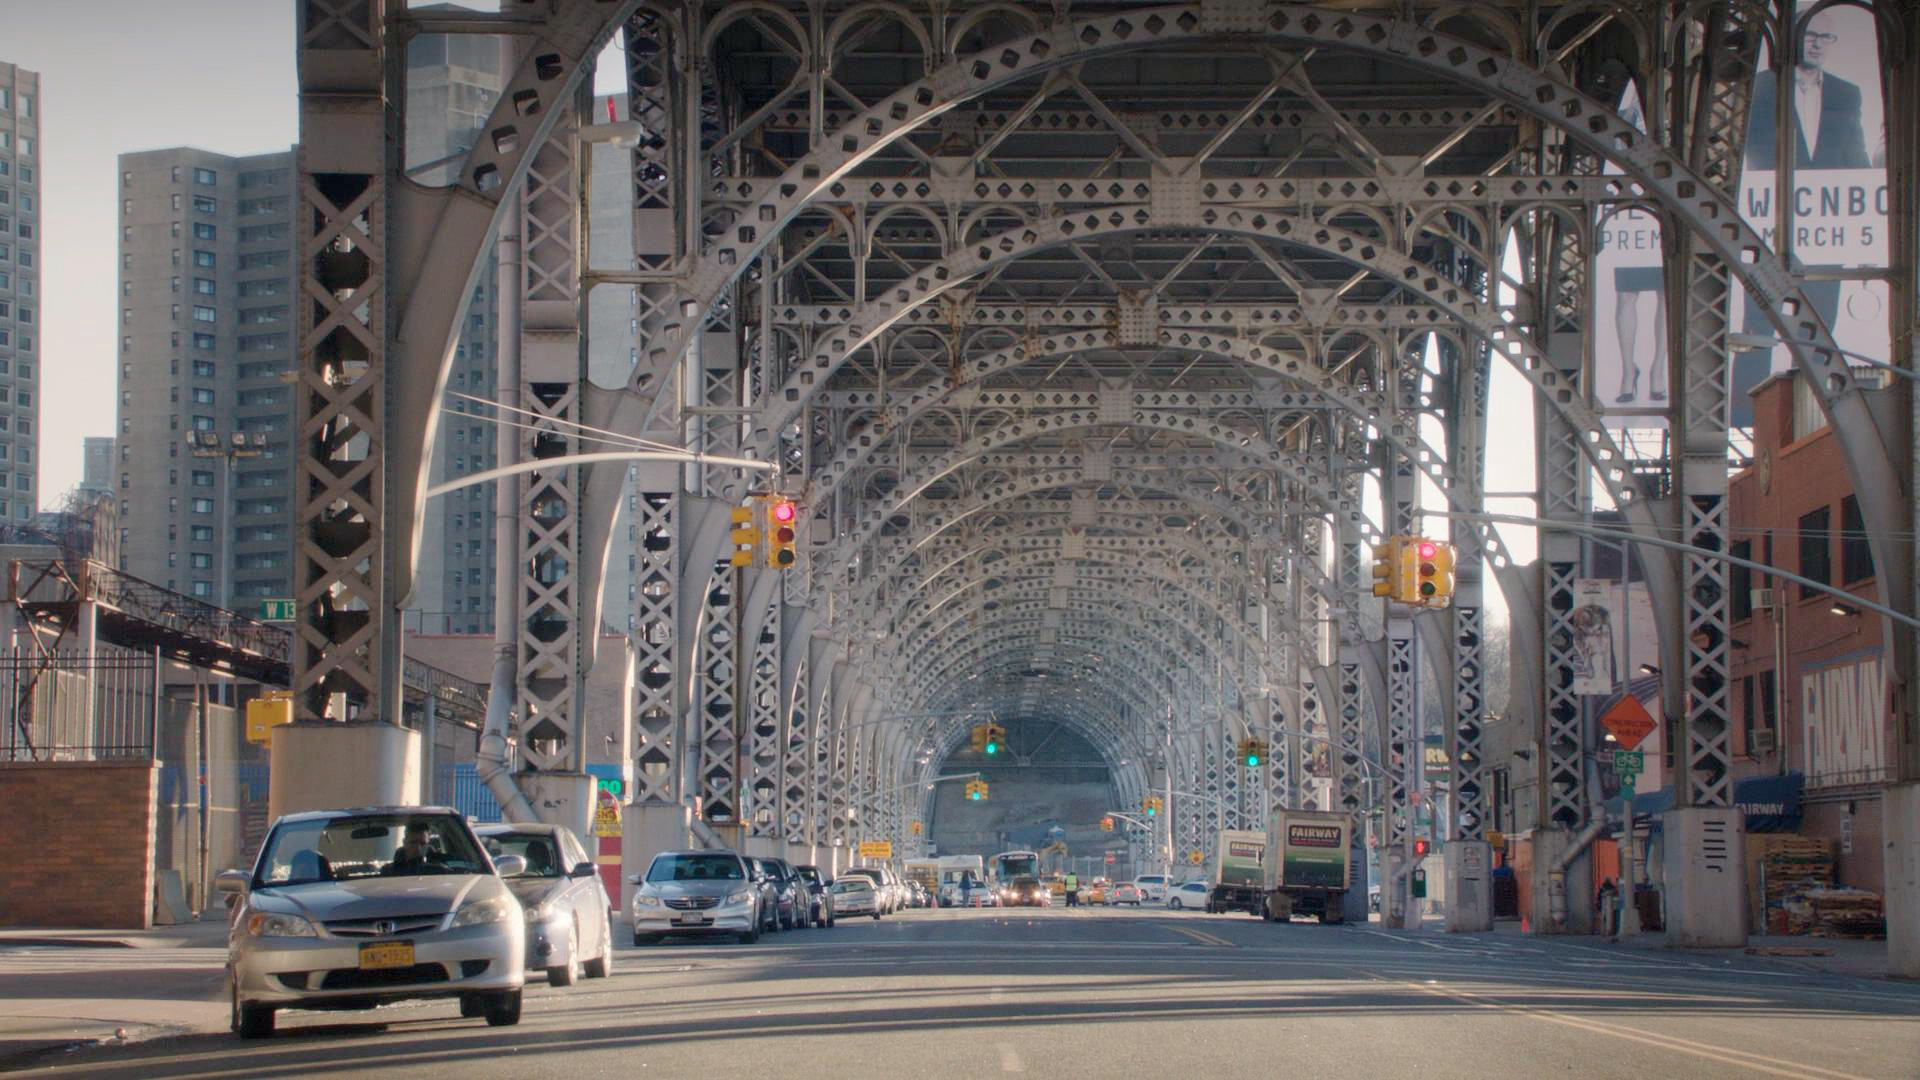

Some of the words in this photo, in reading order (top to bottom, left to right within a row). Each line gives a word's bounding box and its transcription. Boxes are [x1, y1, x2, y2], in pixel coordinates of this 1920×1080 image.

[1762, 226, 1844, 247] MRCH
[1860, 226, 1873, 246] 5
[266, 602, 278, 619] W
[1291, 826, 1339, 839] FAIRWAY
